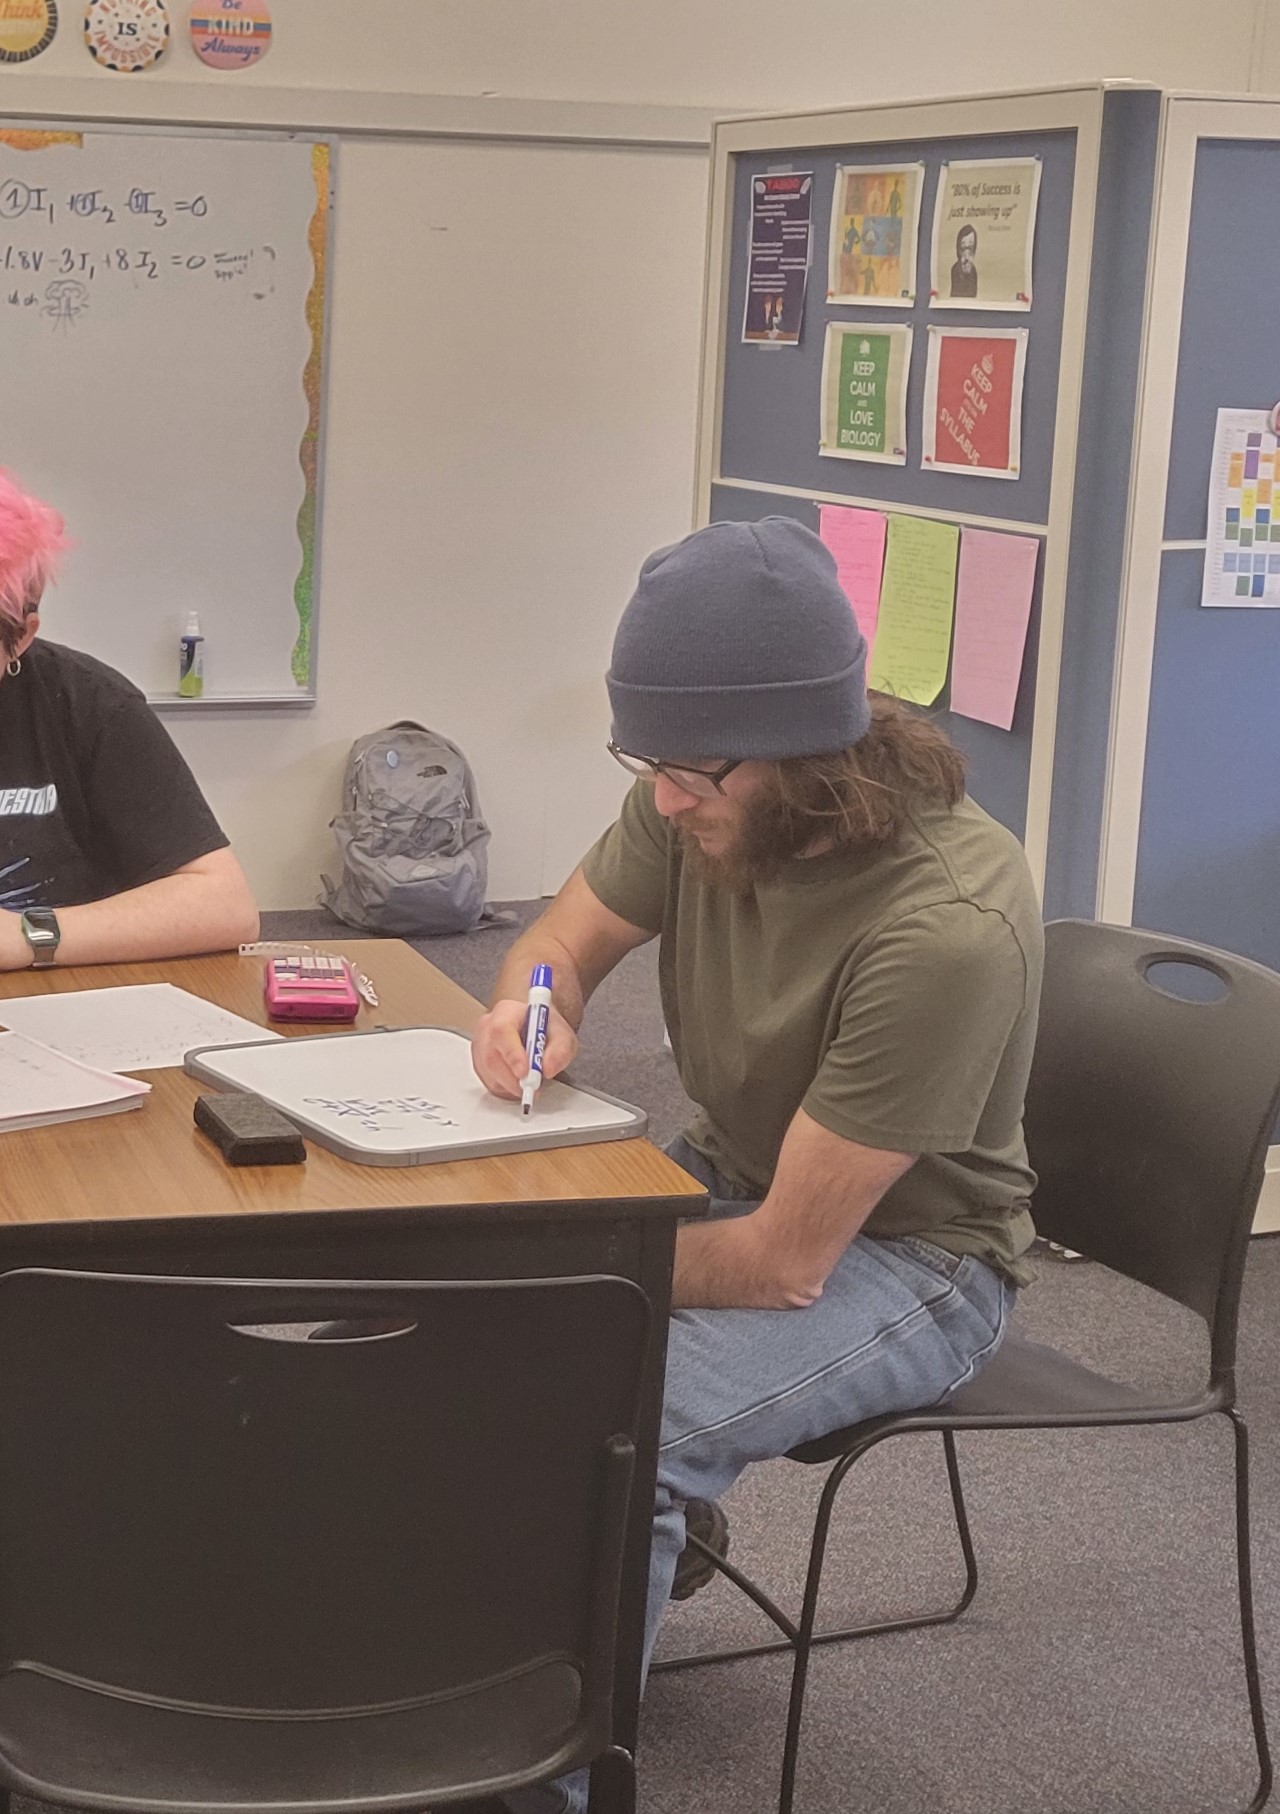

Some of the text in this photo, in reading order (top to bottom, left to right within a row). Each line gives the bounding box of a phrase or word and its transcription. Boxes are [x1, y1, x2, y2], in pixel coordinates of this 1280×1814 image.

[117, 22, 137, 36] IS
[207, 15, 255, 36] KIND
[93, 31, 160, 64] IMPOSSIBLE
[201, 37, 261, 62] Always
[971, 182, 981, 198] of
[981, 182, 1012, 196] Success
[1013, 181, 1021, 195] is
[947, 204, 965, 221] just
[965, 203, 1000, 220] showing
[853, 360, 875, 376] KEEP
[970, 363, 992, 393] KEEP
[849, 380, 876, 397] CALM
[963, 379, 988, 416] CALM
[849, 409, 874, 426] LOVE
[958, 406, 976, 435] THE
[840, 428, 881, 447] BIOLOGY
[939, 407, 980, 466] SYLLABUS
